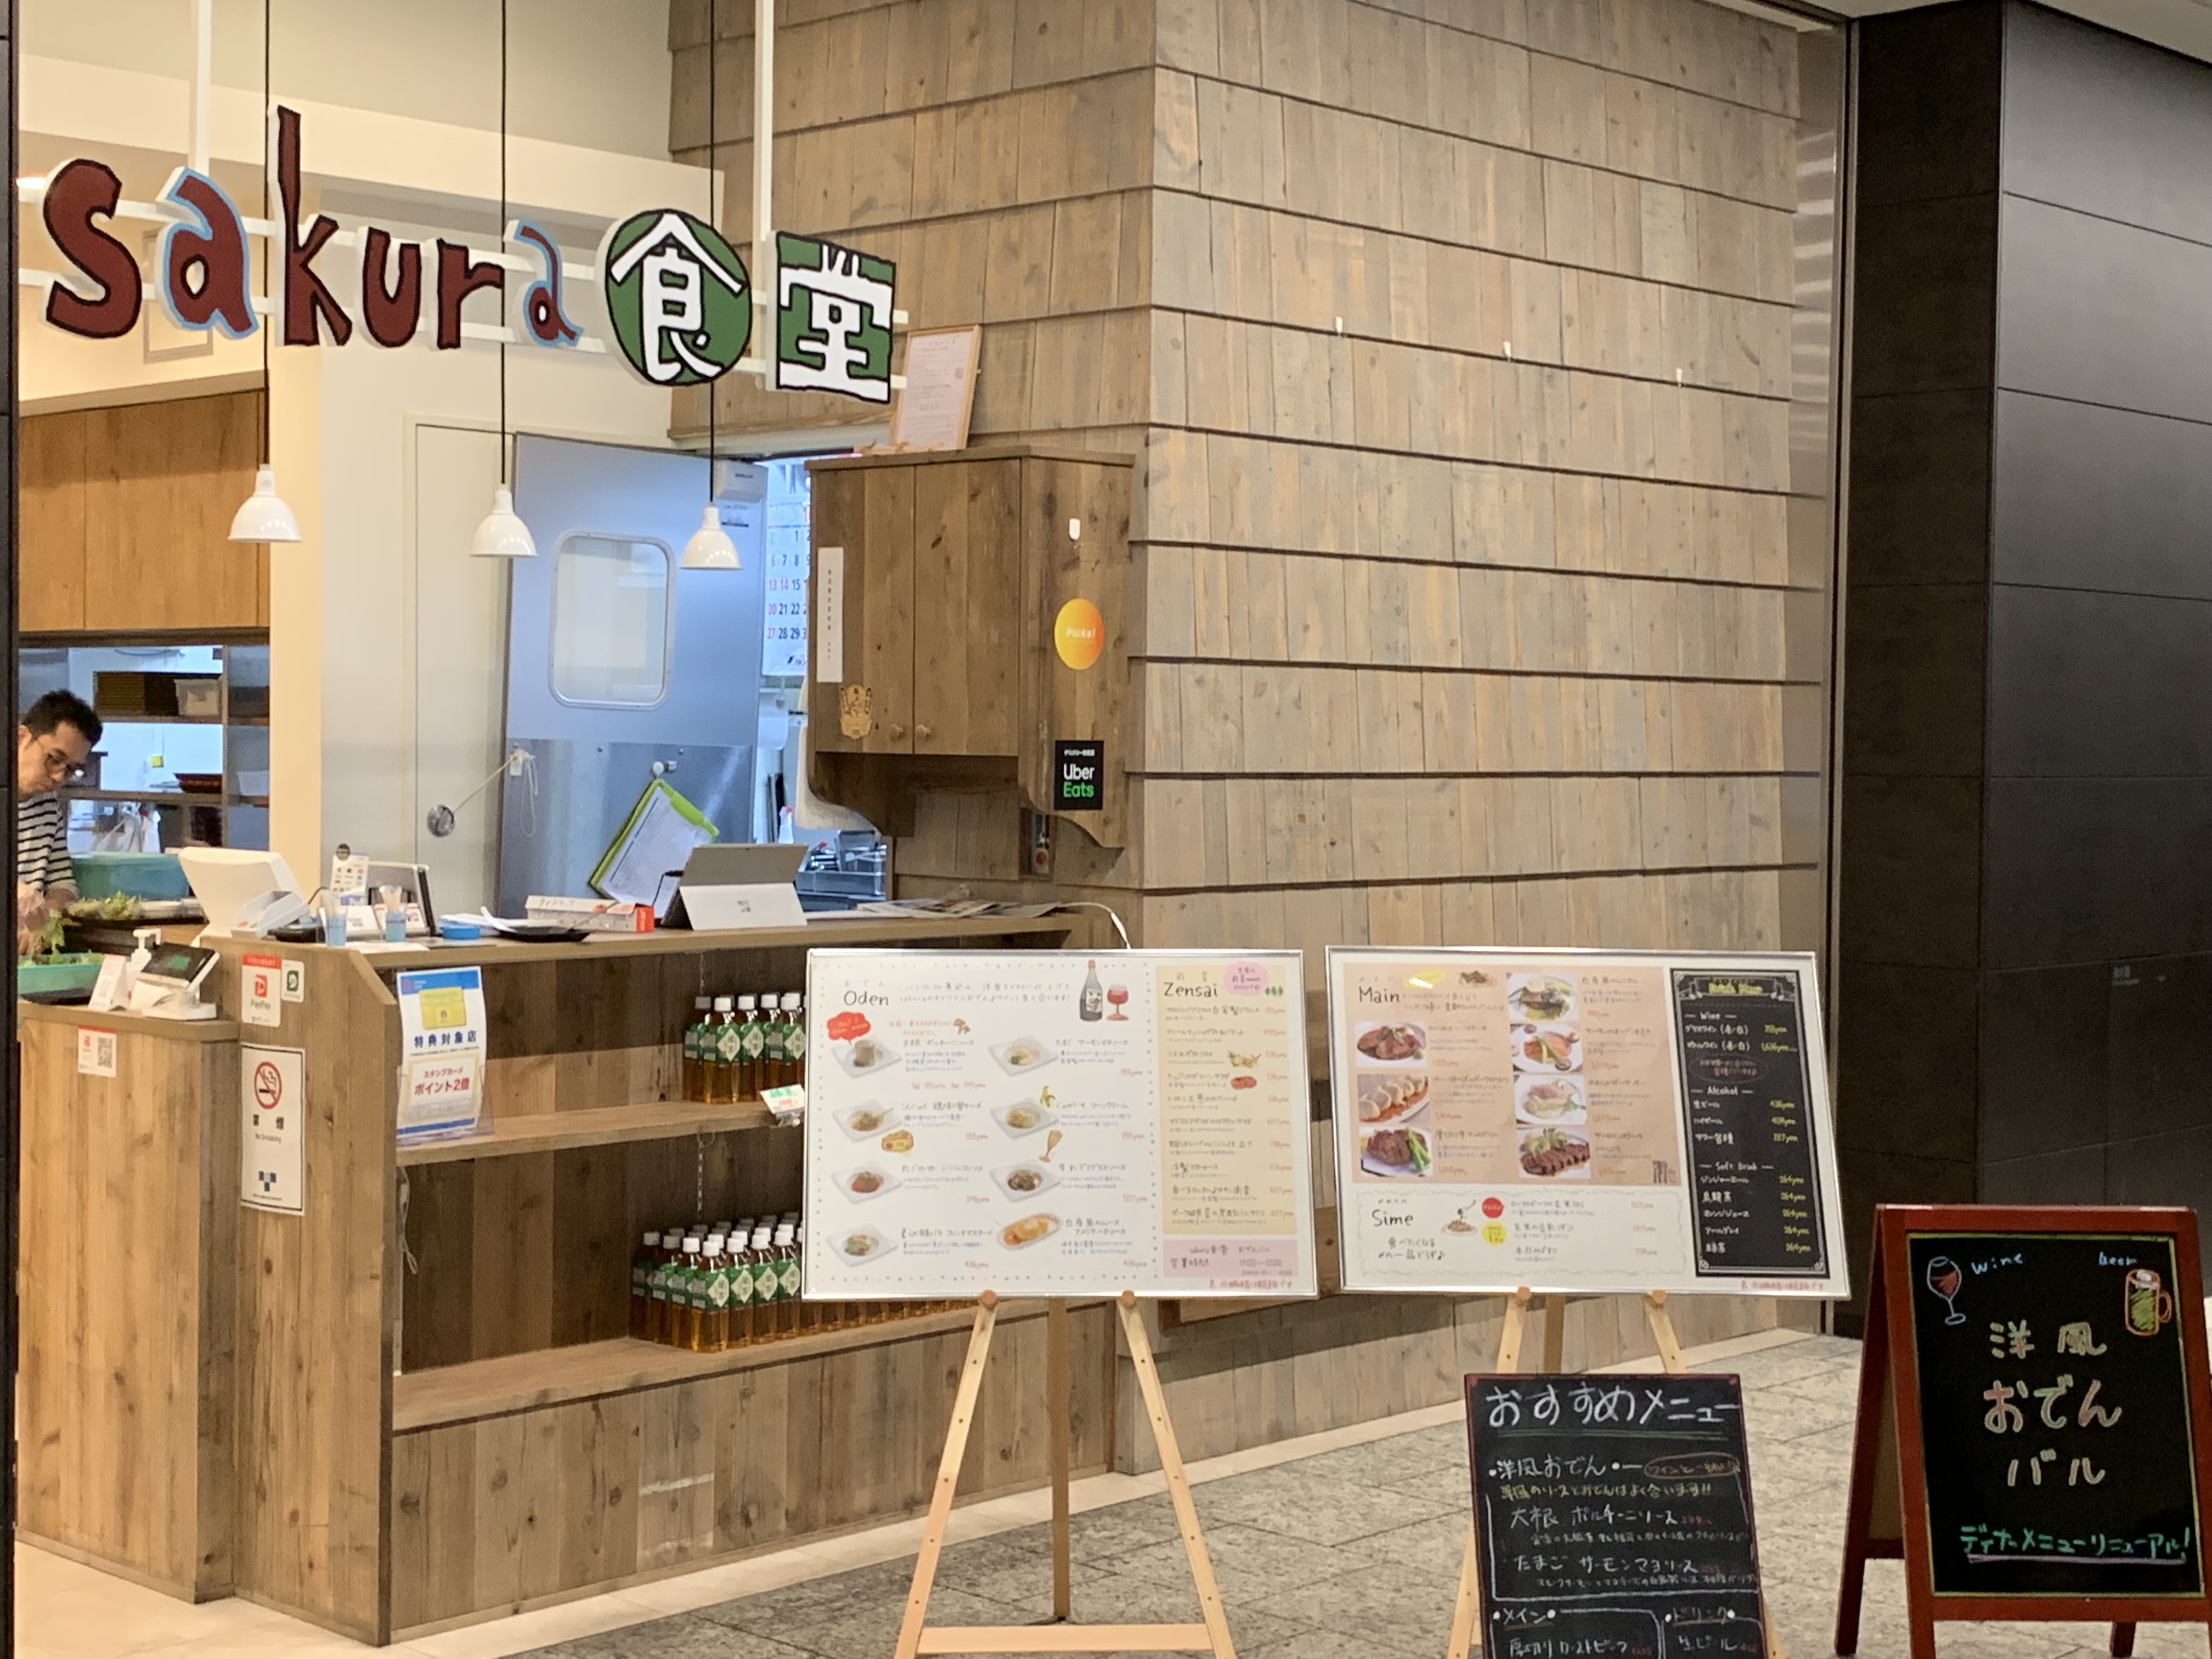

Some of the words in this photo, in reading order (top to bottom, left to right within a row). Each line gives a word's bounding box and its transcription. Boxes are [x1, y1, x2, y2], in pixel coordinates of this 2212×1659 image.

[43, 105, 583, 352] sakura
[607, 211, 895, 402] 食堂
[771, 555, 775, 566] 6
[782, 555, 787, 565] 7
[794, 555, 798, 566] 8
[769, 579, 777, 590] 13
[780, 579, 788, 590] 14
[792, 579, 800, 590] 15
[768, 603, 776, 614] 20
[779, 603, 788, 614] 21
[791, 603, 800, 614] 22
[768, 627, 775, 639] 27
[779, 627, 788, 639] 28
[790, 627, 800, 639] 29
[1063, 763, 1095, 780] Uber
[1063, 782, 1095, 798] Eats
[1163, 981, 1219, 997] Zensai
[1358, 985, 1400, 1005] Main
[250, 998, 271, 1011] PayPay
[844, 990, 889, 1006] Oden
[1700, 1011, 1721, 1020] Wine
[414, 1030, 477, 1049] 特典対象店
[424, 1066, 464, 1079] スタンプカード
[414, 1077, 470, 1096] ポイント2倍
[1707, 1086, 1738, 1096] Alcohol
[1371, 1208, 1414, 1227] Sime
[2098, 1251, 2138, 1266] beer
[1989, 1318, 2107, 1359] 洋風
[1485, 1381, 1741, 1426] おすすめメニュー
[1983, 1374, 2122, 1434] おでん
[1497, 1453, 1606, 1480] 洋風おでん
[2007, 1448, 2106, 1487] バル
[1510, 1506, 1559, 1532] 大根
[1514, 1554, 1568, 1572] たまご
[1503, 1607, 1547, 1624] メイン
[1673, 1607, 1728, 1625] ドリンク
